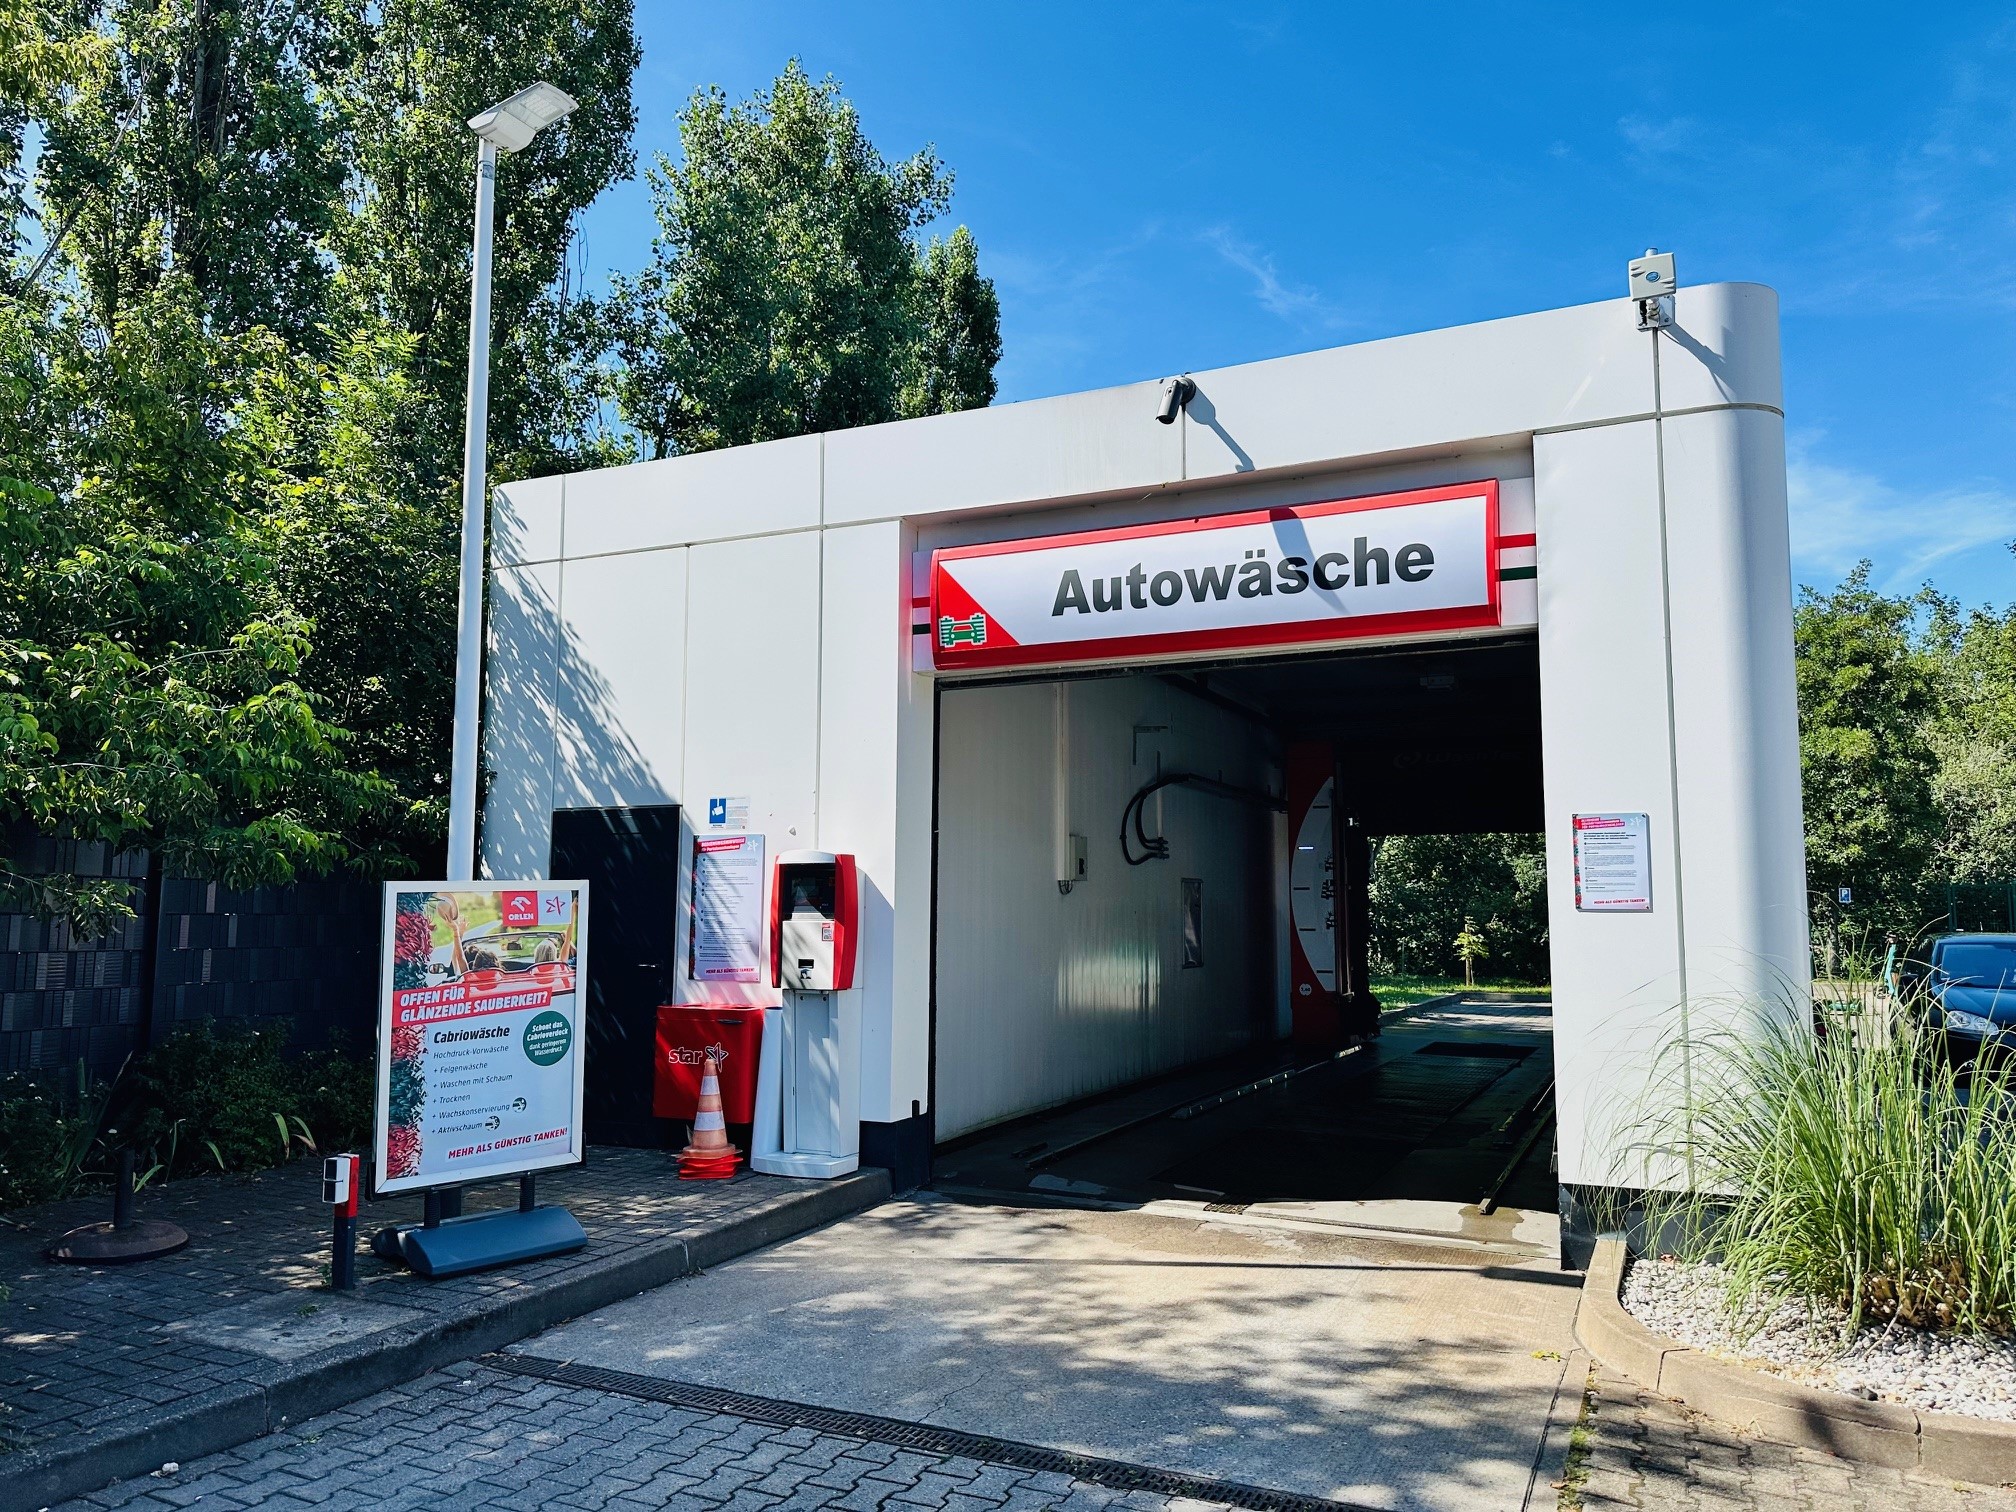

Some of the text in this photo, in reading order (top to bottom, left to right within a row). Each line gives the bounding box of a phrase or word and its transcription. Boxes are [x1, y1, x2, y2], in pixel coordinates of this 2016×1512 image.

[1052, 536, 1435, 617] Autowäsche
[1842, 889, 1848, 898] P
[508, 913, 534, 921] ORLEN
[400, 987, 465, 1007] OFFEN FÜR
[401, 991, 548, 1023] GLÄNZENDE SAUBERKEIT?
[526, 1027, 568, 1041] Cabrioverdeck
[532, 1021, 563, 1033] Schont das
[433, 1026, 511, 1044] Cabriowäsche
[433, 1044, 509, 1059] Hochdruck-Vorwäsche
[669, 1047, 703, 1064] star
[440, 1062, 488, 1074] Felgenwäsche
[440, 1078, 471, 1089] Waschen
[473, 1076, 484, 1085] mit
[486, 1074, 513, 1083] Schaum
[440, 1094, 471, 1104] Trocknen
[439, 1103, 510, 1119] Wachskonservierung
[437, 1122, 483, 1134] Aktivschaum
[448, 1147, 474, 1159] MEHR
[476, 1143, 492, 1154] ALS
[494, 1135, 531, 1150] GÜNSTIG
[533, 1127, 568, 1142] TANKEN!
